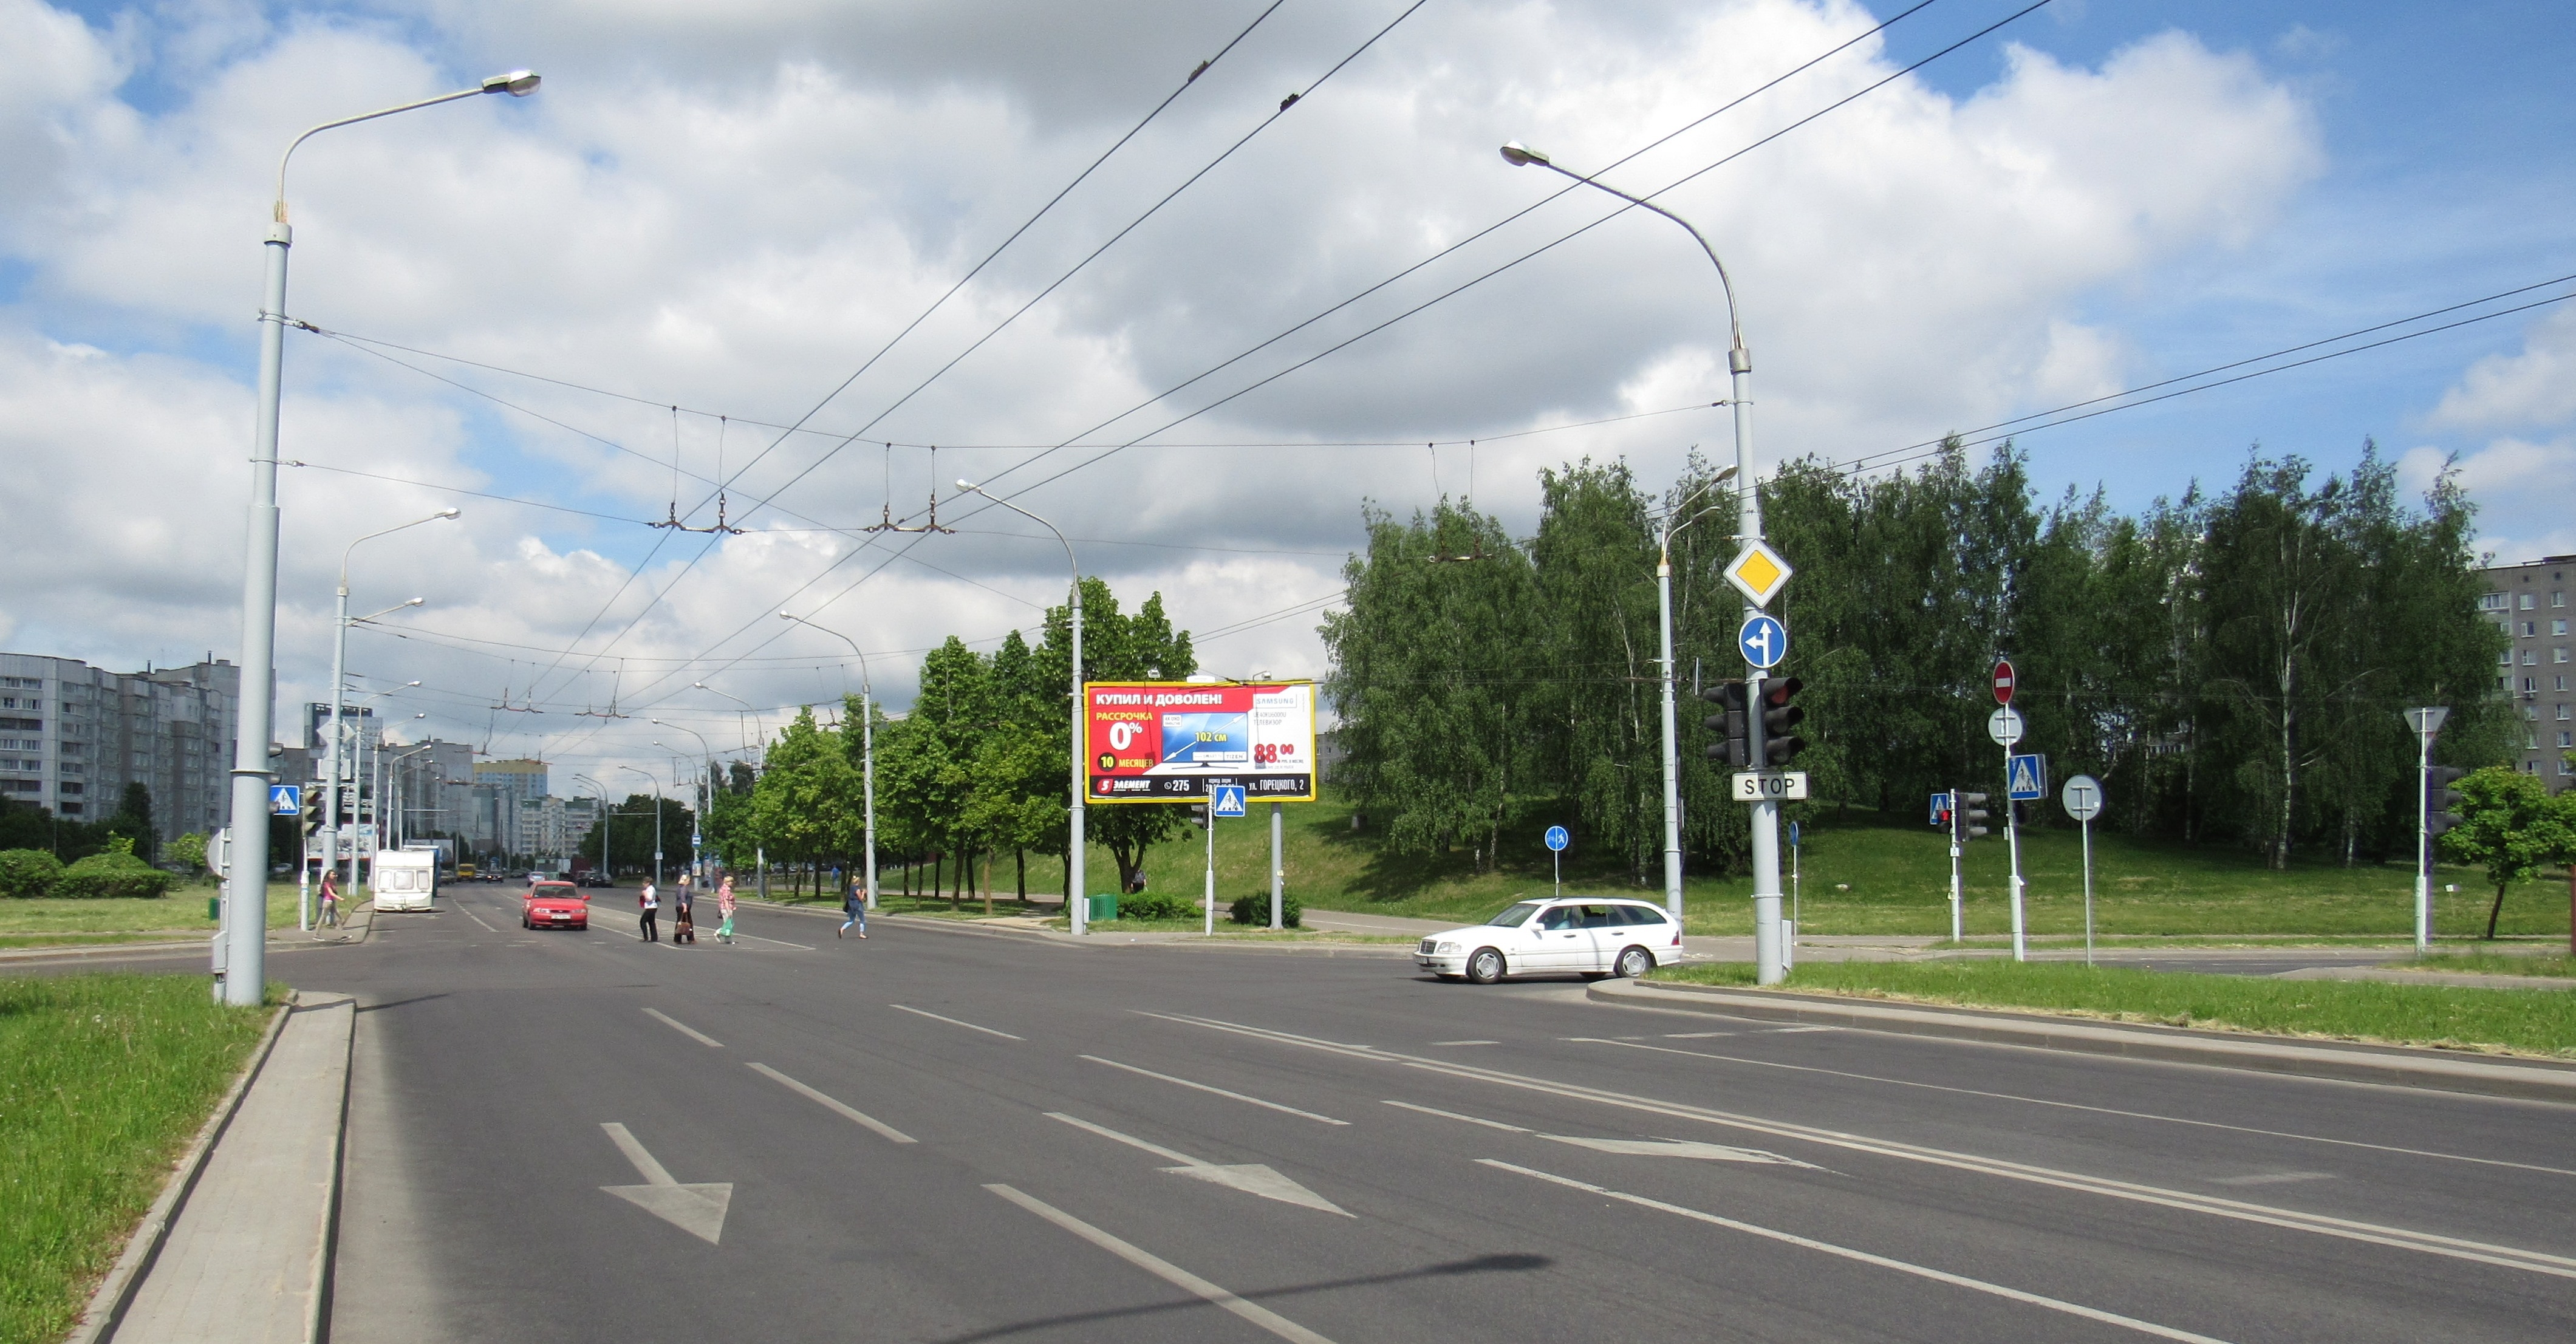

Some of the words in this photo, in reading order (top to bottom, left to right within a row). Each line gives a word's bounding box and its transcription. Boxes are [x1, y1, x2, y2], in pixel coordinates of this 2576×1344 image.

[1096, 694, 1141, 705] КУПИЛ
[1143, 694, 1153, 705] И
[1155, 694, 1223, 708] ДОВОЛЕН!
[1096, 712, 1153, 721] РАССРОЧКА
[1109, 721, 1143, 751] 0%
[1195, 732, 1212, 742] 102
[1101, 756, 1114, 768] 10
[1118, 759, 1154, 769] МЕСЯЦЕВ
[1101, 780, 1110, 791] 5
[1113, 780, 1151, 789] ЭЛЕМЕНТ
[1172, 779, 1190, 791] 275
[1260, 779, 1297, 792] ГОРЕЦКОГО,
[1299, 779, 1304, 790] 2
[1744, 778, 1795, 795] STOP
